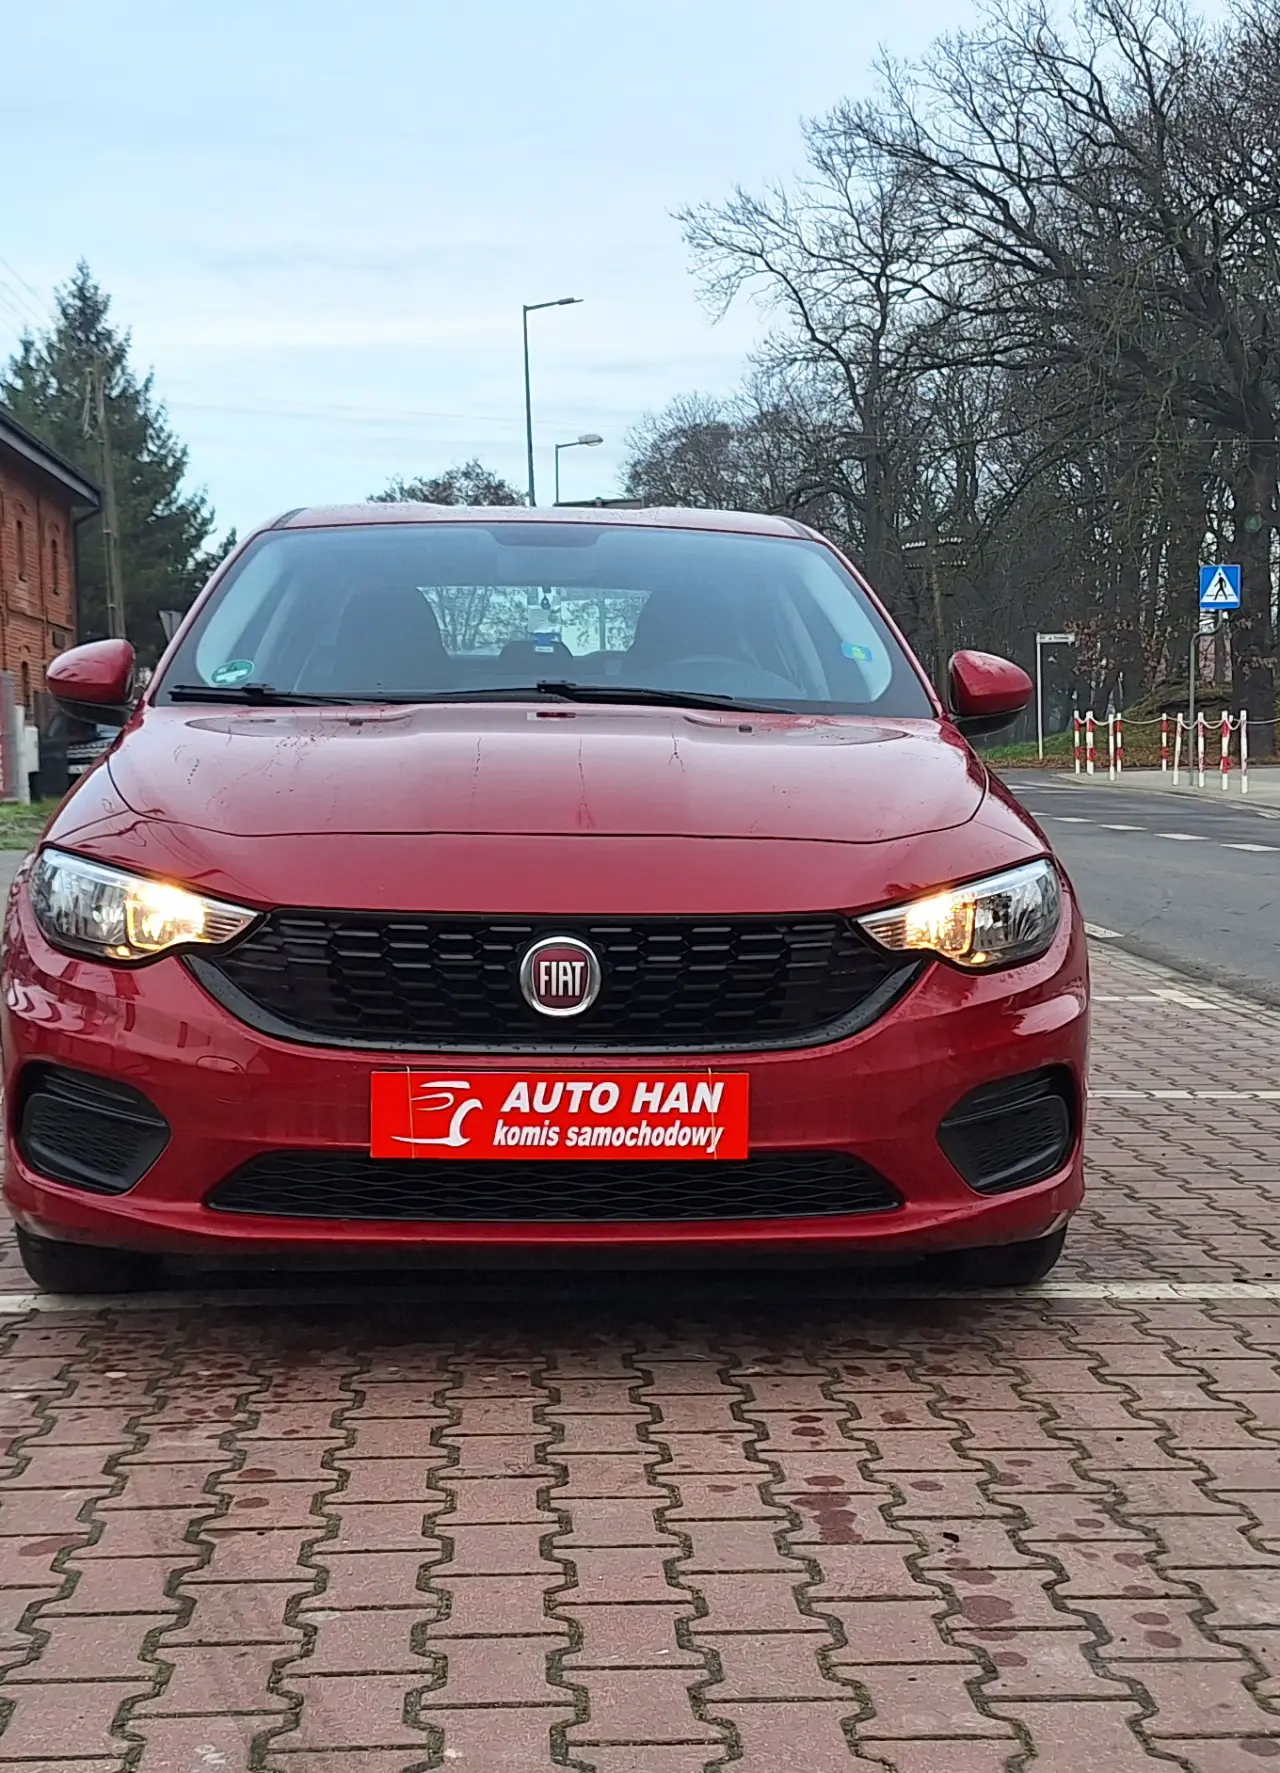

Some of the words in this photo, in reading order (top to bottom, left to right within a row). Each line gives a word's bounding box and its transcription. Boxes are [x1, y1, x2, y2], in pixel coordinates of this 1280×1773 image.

[539, 961, 585, 997] FIAT
[500, 1082, 621, 1113] AUTO
[631, 1082, 724, 1113] HAN
[493, 1119, 560, 1147] komis
[565, 1120, 724, 1154] samochodowy
